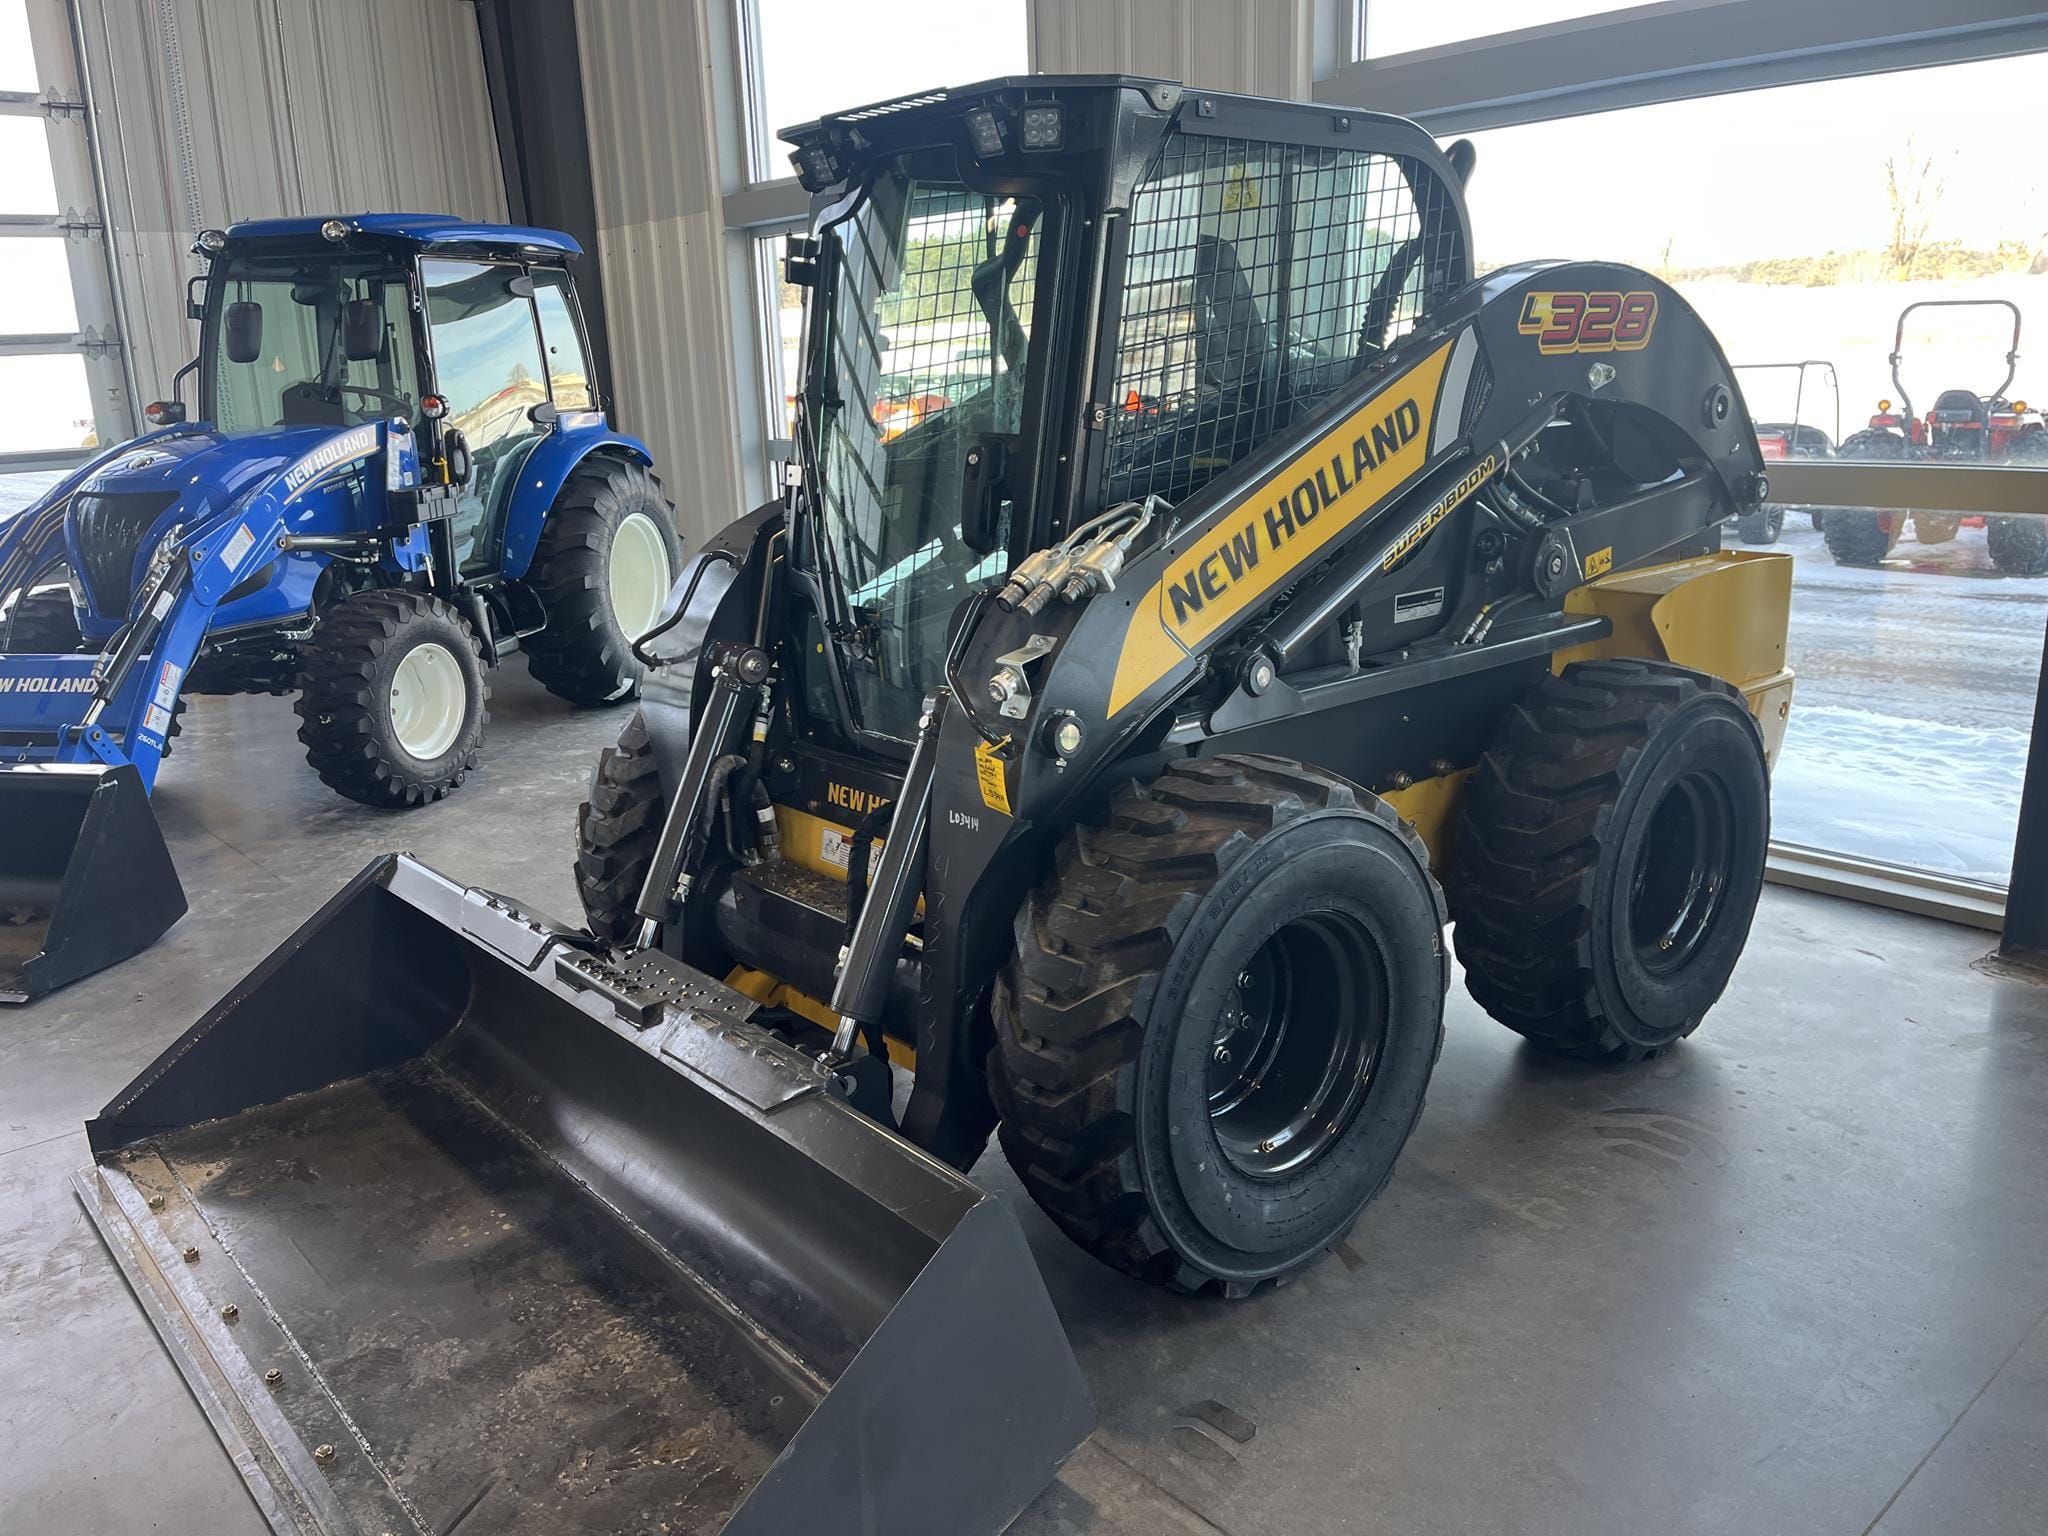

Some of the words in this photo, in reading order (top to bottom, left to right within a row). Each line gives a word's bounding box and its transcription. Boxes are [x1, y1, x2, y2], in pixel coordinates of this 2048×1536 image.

[1519, 292, 1657, 353] L328
[284, 460, 315, 492] NEW
[315, 431, 369, 471] HOLLAND
[1167, 521, 1259, 626] NEW
[1263, 398, 1420, 550] HOLLAND
[16, 678, 98, 692] HOLLAND
[828, 782, 865, 812] NEW
[1209, 870, 1250, 920] BABY
